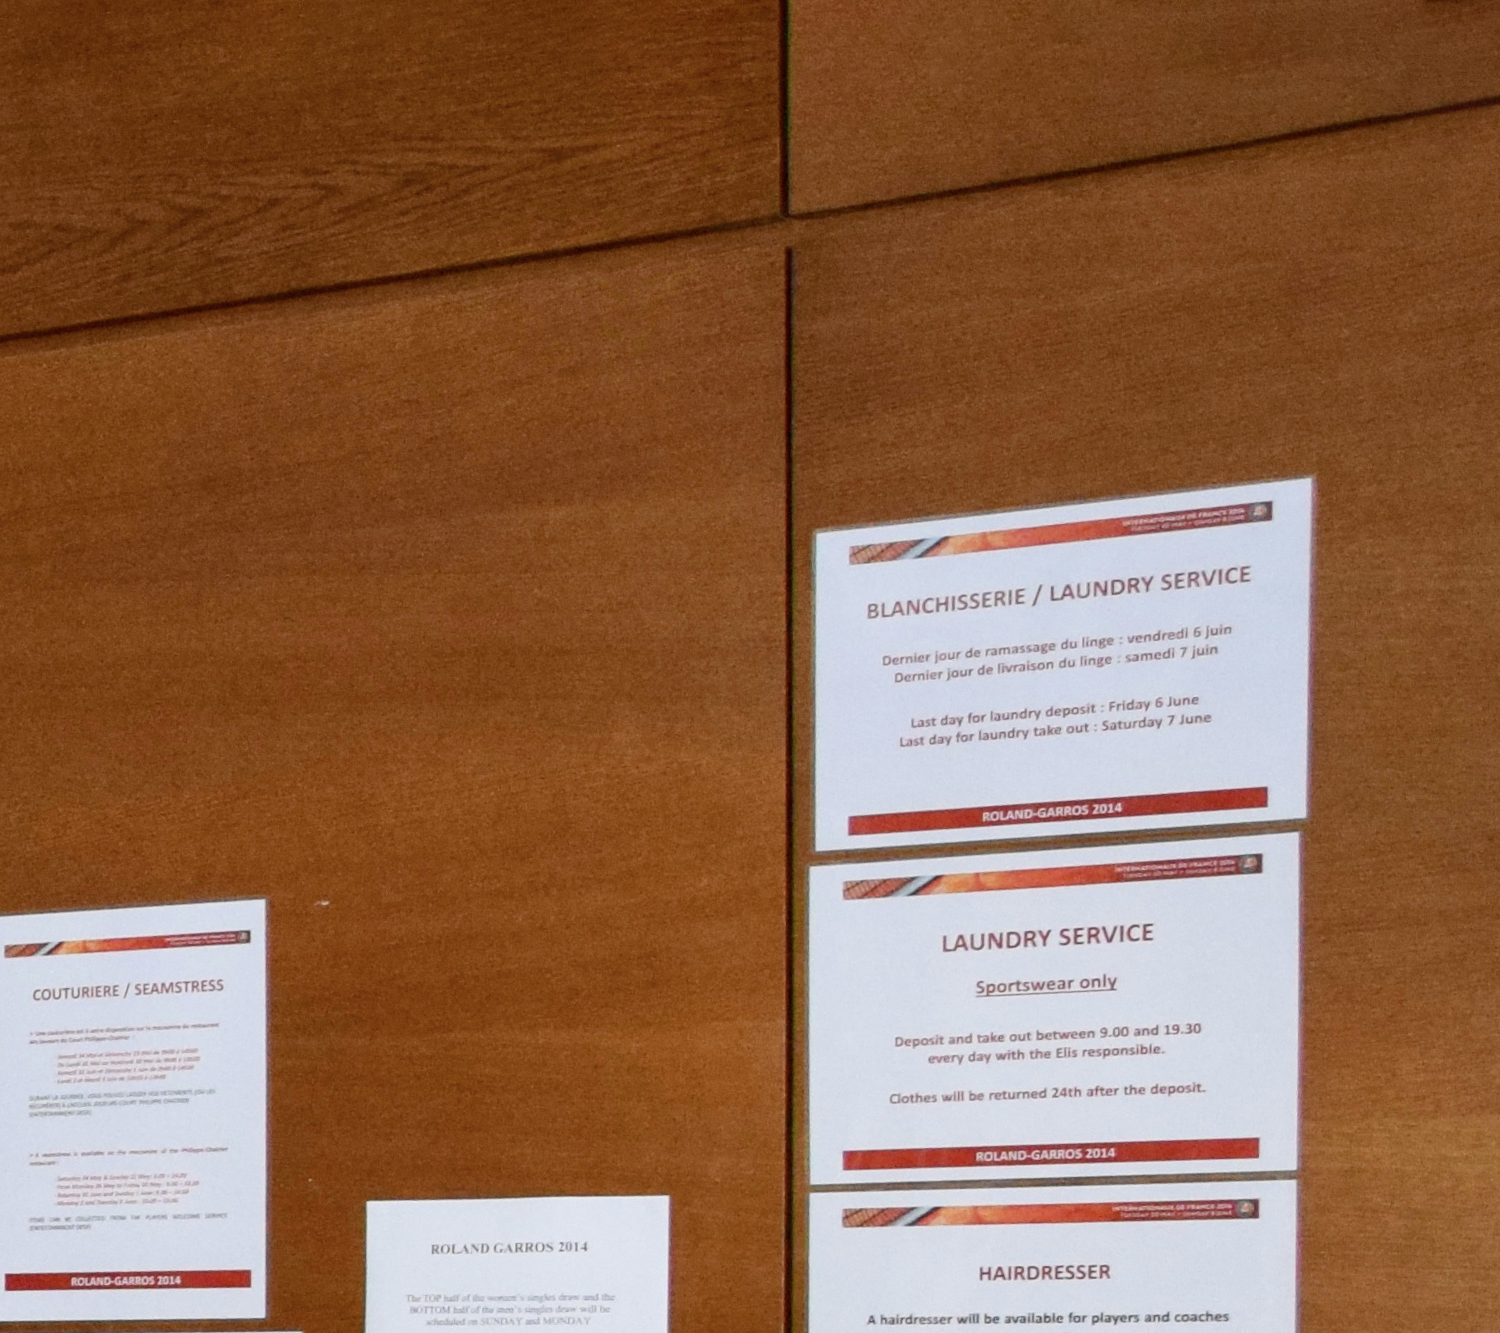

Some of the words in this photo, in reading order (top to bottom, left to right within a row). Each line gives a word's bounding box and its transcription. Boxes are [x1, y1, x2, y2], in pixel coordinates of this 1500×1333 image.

[867, 588, 1025, 618] BLANCHISSERIE
[1049, 576, 1154, 601] LAUNDRY
[1160, 565, 1251, 590] SERVICE
[882, 653, 931, 666] Dernier
[934, 650, 961, 664] jour
[964, 647, 981, 658] de
[984, 642, 1056, 656] ramassage
[1060, 638, 1078, 650] du
[1081, 636, 1114, 649] linge
[1126, 627, 1188, 643] vendredi
[1192, 626, 1202, 638] 6
[1204, 624, 1232, 639] juin
[910, 717, 937, 728] Last
[940, 714, 964, 727] day
[967, 712, 986, 724] for
[989, 708, 1041, 721] laundry
[1045, 703, 1096, 718] deposit
[1108, 699, 1151, 711] Friday
[1154, 696, 1163, 708] 6
[1166, 696, 1199, 707] June
[982, 805, 1089, 821] ROLAND-GARROS
[1092, 802, 1122, 814] 2014
[942, 929, 1051, 952] LAUNDRY
[1059, 923, 1153, 945] SERVICE
[32, 984, 119, 1001] COUTURIERE
[134, 978, 224, 995] SEAMSTRESS
[976, 979, 1075, 995] Sportswear
[1079, 974, 1117, 990] only
[894, 1034, 944, 1048] Deposit
[948, 1032, 973, 1045] and
[976, 1031, 1005, 1043] take
[1008, 1031, 1031, 1042] out
[1035, 1030, 1095, 1041] between
[1133, 1024, 1159, 1037] and
[1164, 1022, 1202, 1035] 19.30
[927, 1054, 964, 1065] every
[967, 1051, 992, 1064] day
[995, 1049, 1025, 1061] with
[1028, 1048, 1051, 1060] the
[1055, 1046, 1077, 1059] Elis
[1081, 1043, 1165, 1058] responsible.
[889, 1092, 937, 1104] Clothes
[941, 1090, 964, 1102] will
[968, 1090, 984, 1101] be
[988, 1087, 1047, 1100] returned
[1086, 1085, 1119, 1097] after
[1123, 1084, 1146, 1096] the
[1150, 1082, 1206, 1096] deposit.
[975, 1148, 1082, 1161] ROLAND-GARROS
[1084, 1147, 1115, 1159] 2014
[431, 1243, 490, 1254] ROLAND
[493, 1242, 554, 1253] GARROS
[558, 1241, 588, 1252] 2014
[70, 1275, 155, 1286] ROLAND-GARROS
[156, 1275, 181, 1285] 2014
[979, 1264, 1110, 1280] HAIRDRESSER
[866, 1314, 876, 1325] A
[879, 1314, 953, 1325] hairdresser
[956, 1313, 980, 1324] will
[983, 1313, 1000, 1324] be
[1003, 1312, 1064, 1324] available
[1067, 1311, 1087, 1323] for
[1091, 1312, 1140, 1325] players
[1144, 1311, 1170, 1323] and
[1173, 1310, 1230, 1322] coaches
